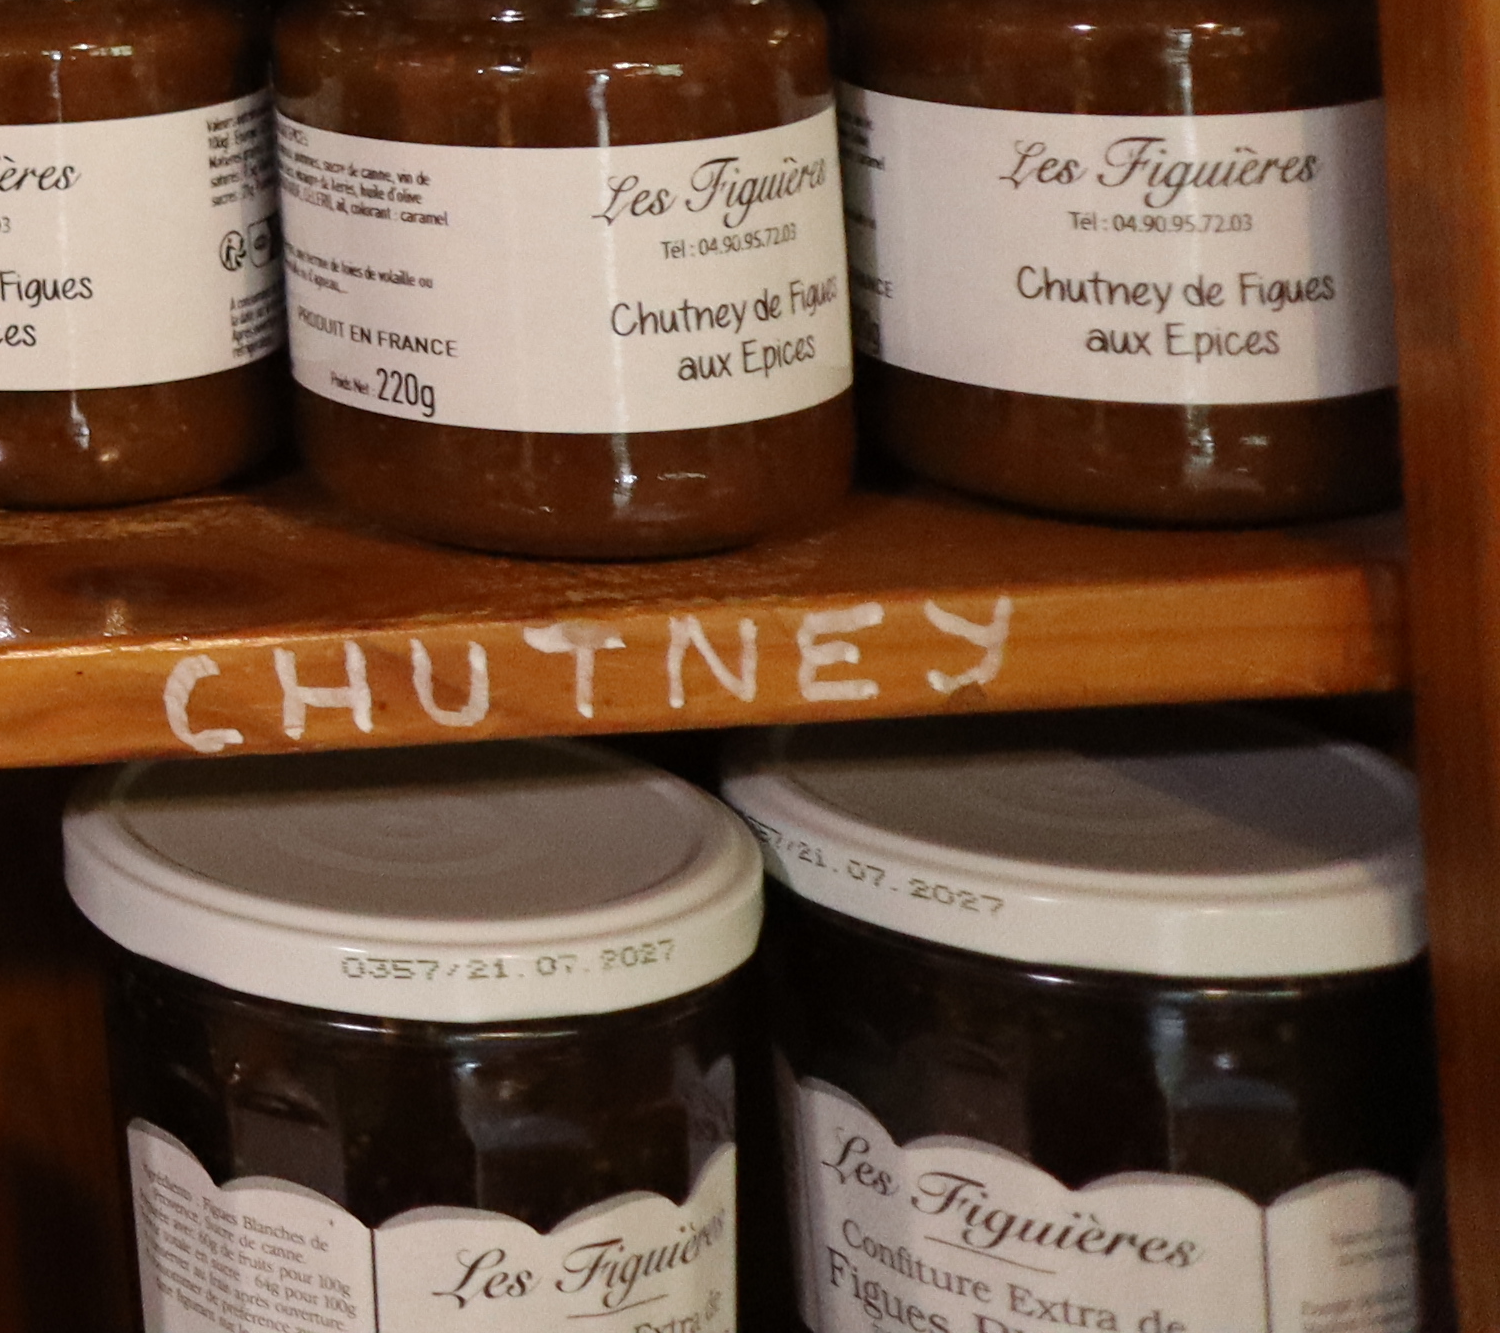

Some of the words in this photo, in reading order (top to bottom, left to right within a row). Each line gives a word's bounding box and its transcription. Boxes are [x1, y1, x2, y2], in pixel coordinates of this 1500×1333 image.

[999, 139, 1088, 191] Les
[1096, 135, 1322, 209] Figuières
[1016, 265, 1172, 312] Chutney
[1183, 273, 1225, 307] de
[1239, 271, 1336, 307] Figues
[1086, 325, 1151, 355] aux
[1165, 323, 1281, 363] Epices
[377, 368, 435, 417] 220g
[164, 597, 1012, 753] CHUTNEY
[822, 1127, 900, 1197] Les
[910, 1171, 1203, 1269] Figuières
[311, 1237, 329, 1252] de
[432, 1247, 540, 1309] Les
[841, 1218, 991, 1304] Confiture
[1007, 1282, 1118, 1332] Extra
[825, 1246, 949, 1333] Figues
